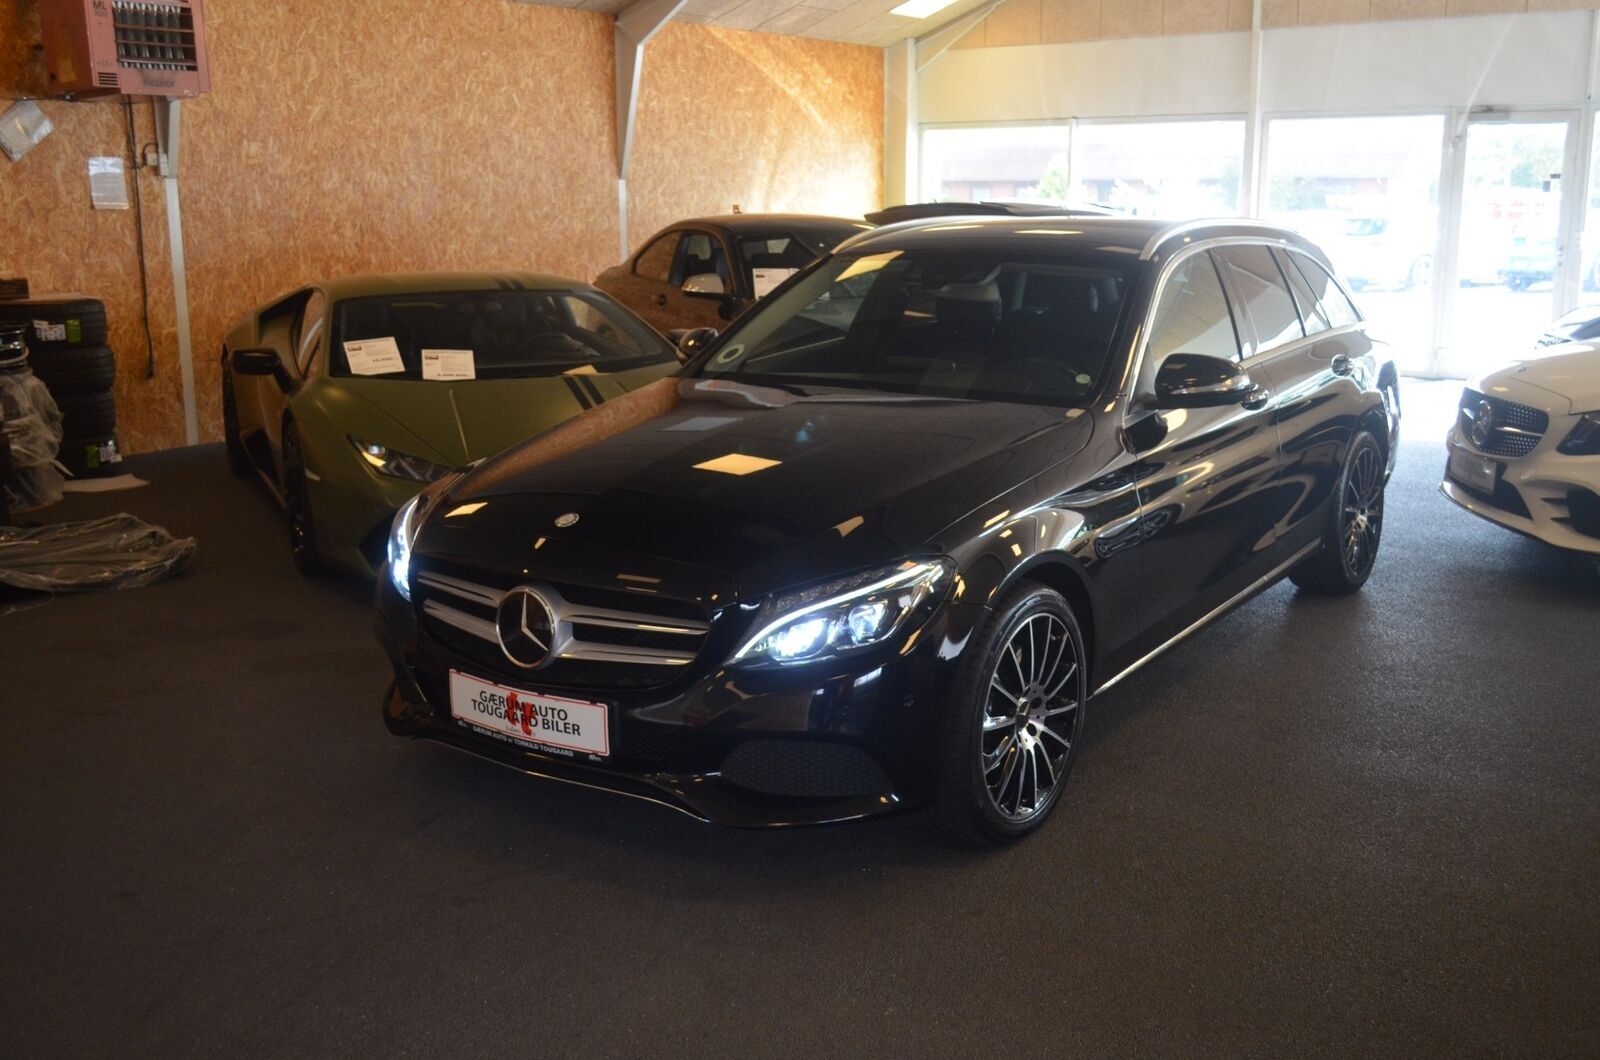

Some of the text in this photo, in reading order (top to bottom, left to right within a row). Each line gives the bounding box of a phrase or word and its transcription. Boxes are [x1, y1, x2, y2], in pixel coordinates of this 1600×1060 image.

[471, 699, 538, 728] TOUGAARD
[542, 719, 581, 736] BILER
[479, 690, 568, 721] GÆRUM AUTO
[540, 745, 574, 757] TOUGAARD
